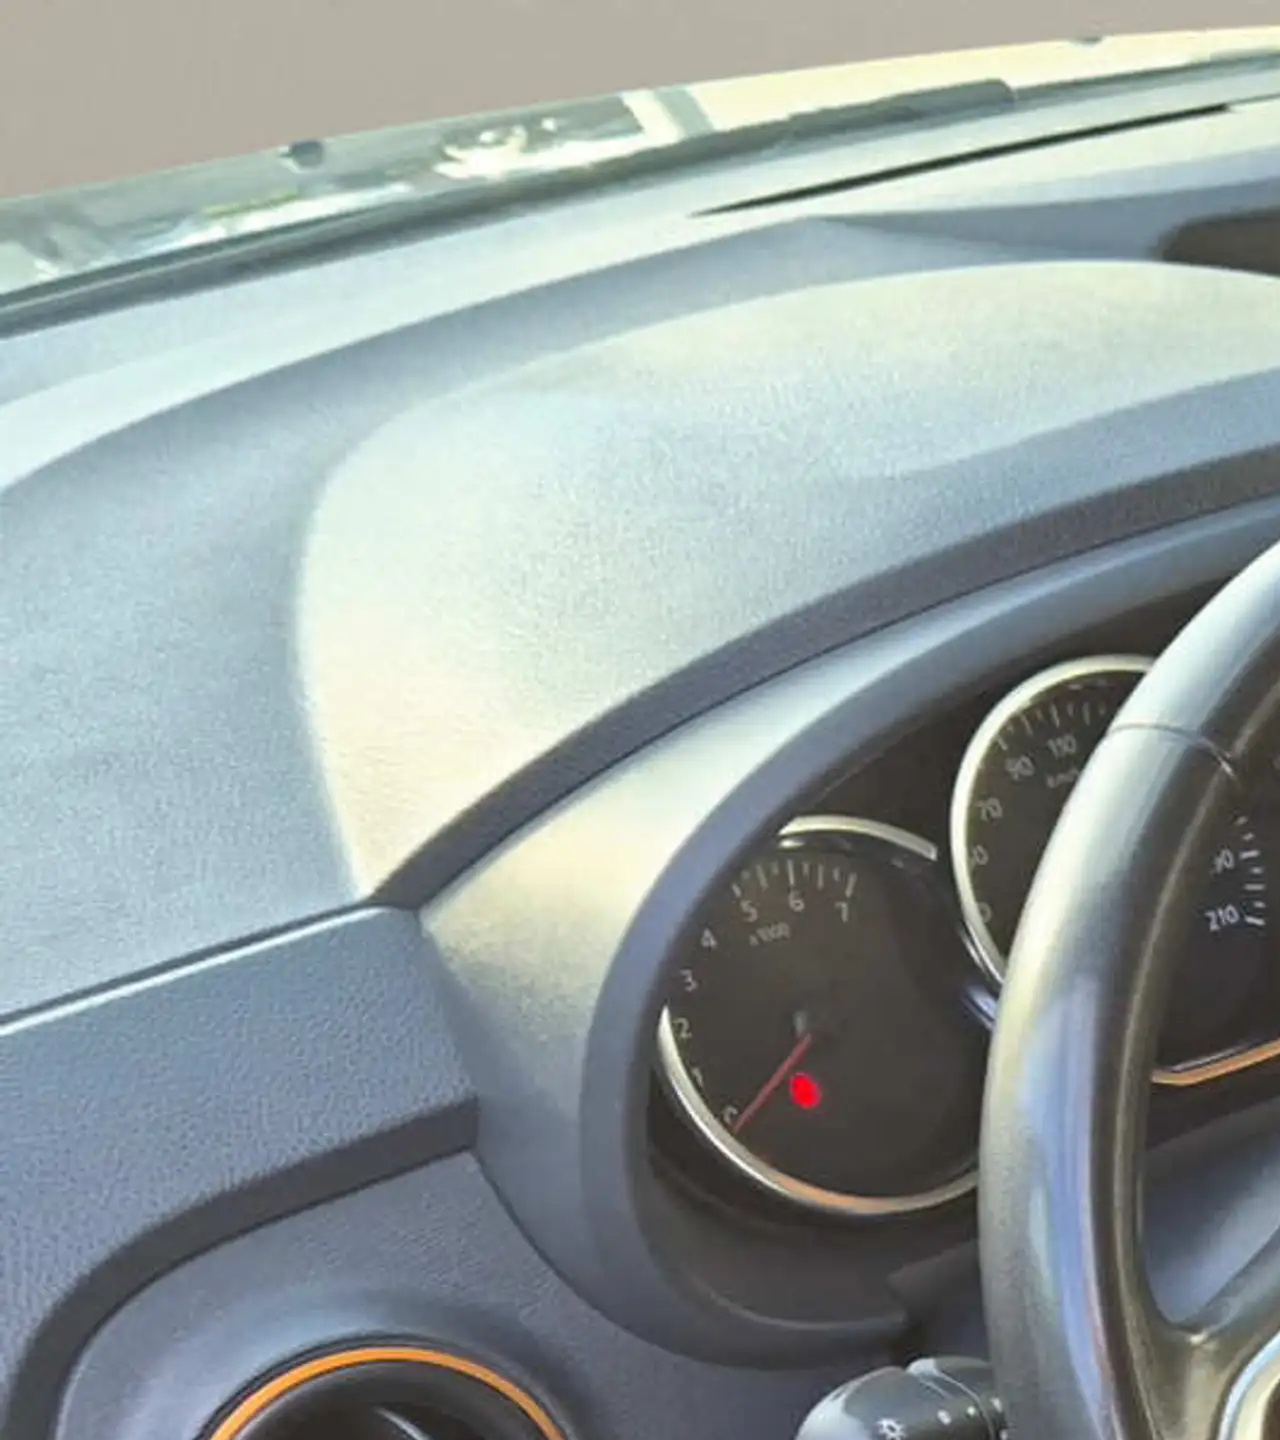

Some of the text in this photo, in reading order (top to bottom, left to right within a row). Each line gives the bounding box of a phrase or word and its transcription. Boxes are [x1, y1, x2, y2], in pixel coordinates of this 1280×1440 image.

[739, 899, 759, 924] 5
[787, 891, 806, 913] 6
[834, 900, 850, 924] 7
[700, 927, 718, 950] 4
[679, 968, 698, 993] 3
